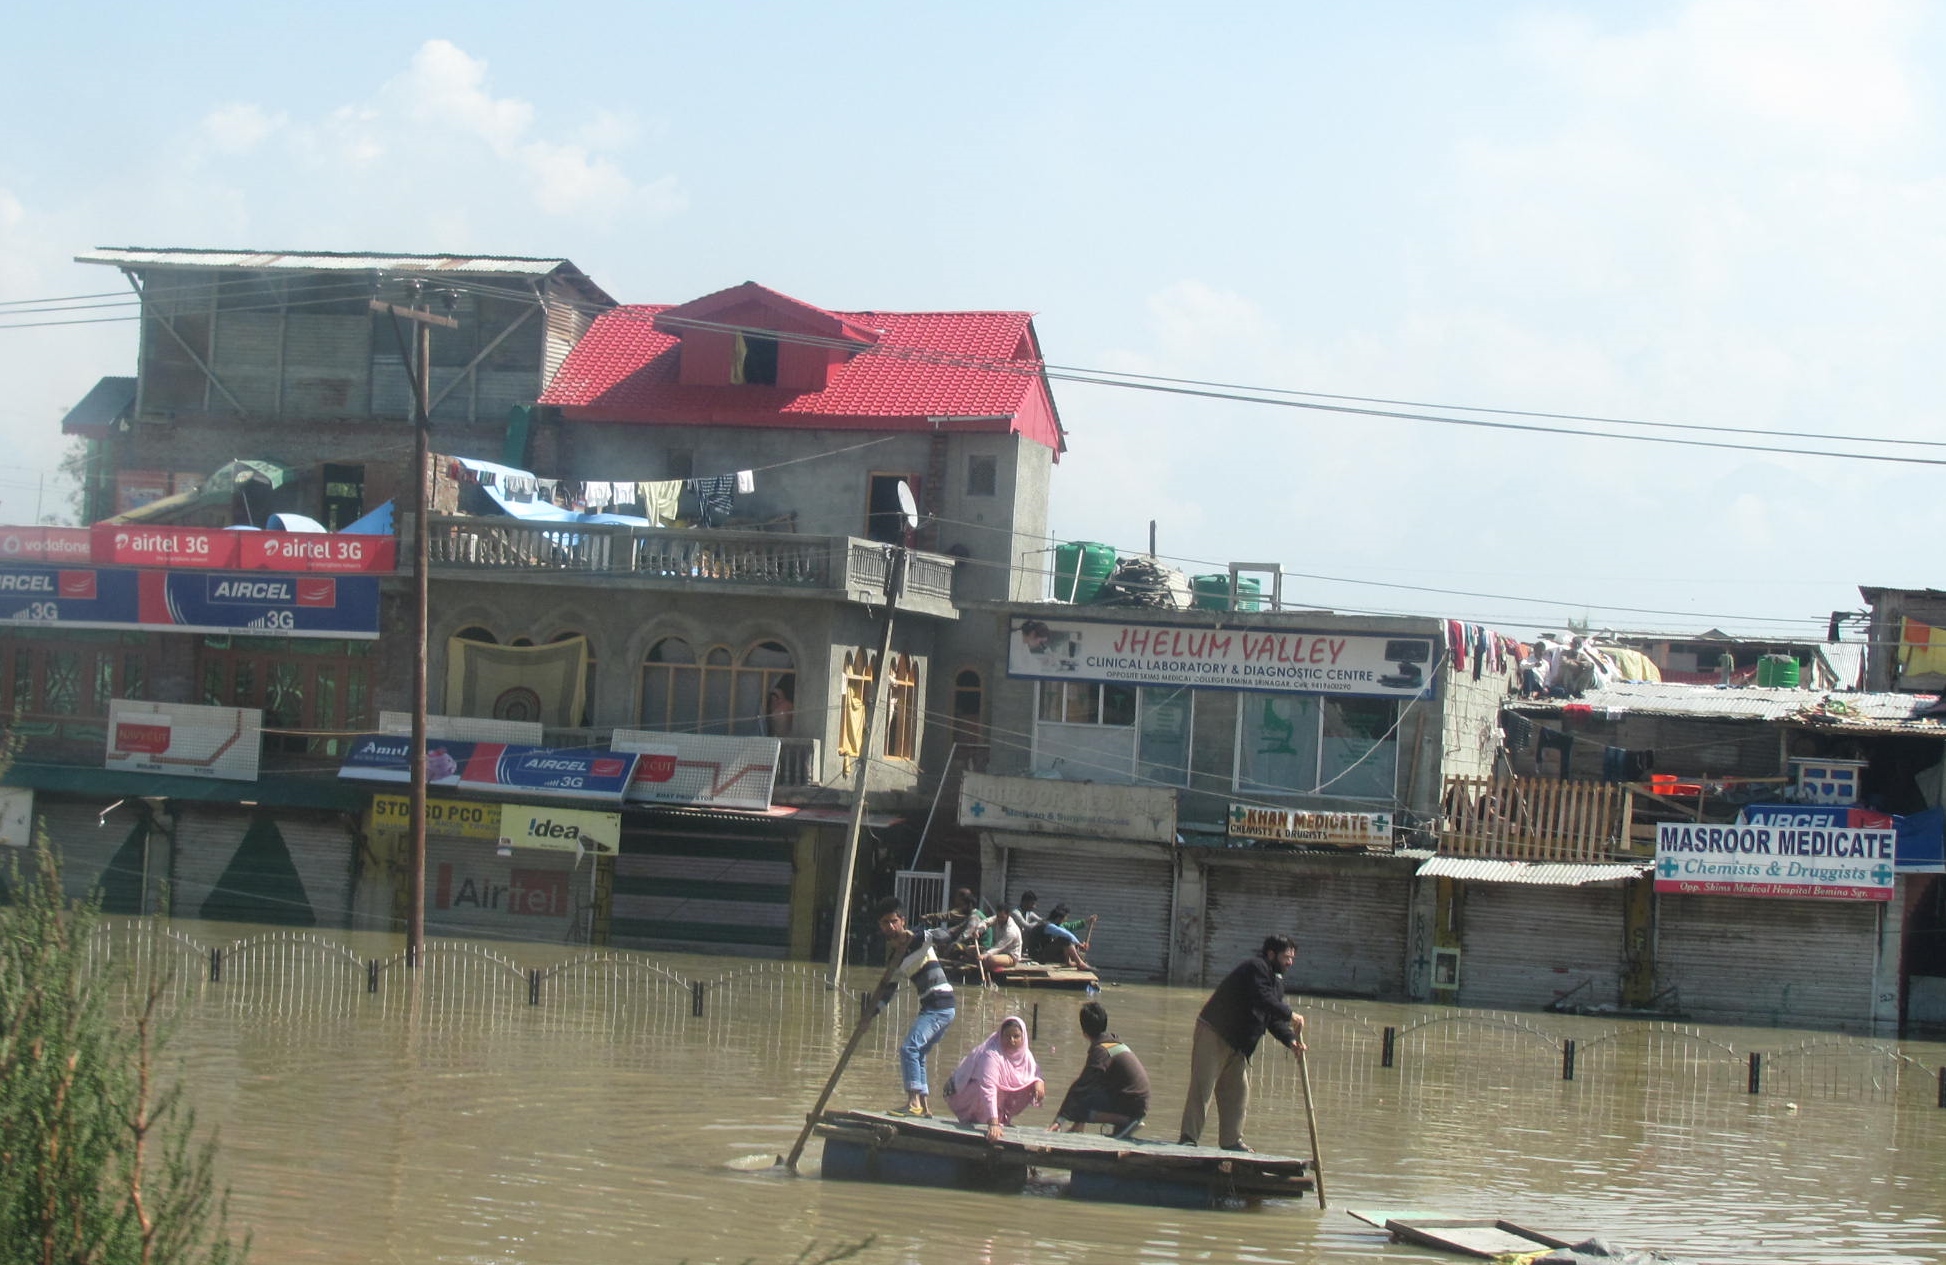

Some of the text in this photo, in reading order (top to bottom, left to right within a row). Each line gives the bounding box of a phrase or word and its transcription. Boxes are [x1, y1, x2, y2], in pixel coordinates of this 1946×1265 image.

[25, 538, 90, 554] vodafone
[132, 535, 209, 554] airtel 3G
[283, 541, 362, 560] airtel 3G
[0, 575, 53, 592] RCEL
[214, 582, 291, 600] AIRCEL
[31, 602, 58, 620] 3G
[266, 611, 294, 629] 3G
[1113, 628, 1346, 665] JHELUM VALLEY
[1086, 656, 1374, 682] CLINICAL LABORATORY & DIAGNOSTIC CENTRE
[1106, 670, 1139, 679] OPPOSITE
[1140, 673, 1160, 681] SKIMS
[1161, 673, 1191, 682] MEDICAL
[1194, 676, 1225, 684] COLLEGE
[1226, 678, 1253, 686] BEMINA
[525, 758, 588, 772] AIRCEL
[560, 776, 583, 788] 3G
[376, 801, 409, 816] STD
[449, 807, 483, 822] PCO
[1246, 808, 1369, 832] KHAN MEDICATE
[1749, 813, 1839, 828] AIRCEL
[1661, 826, 1892, 859] MASROOR MEDICATE
[1684, 858, 1867, 882] Chemists & Druggists
[1680, 881, 1701, 893] Opp.
[1733, 884, 1770, 894] Medical
[1772, 884, 1812, 896] Hospital
[1850, 888, 1868, 899] Sgr.
